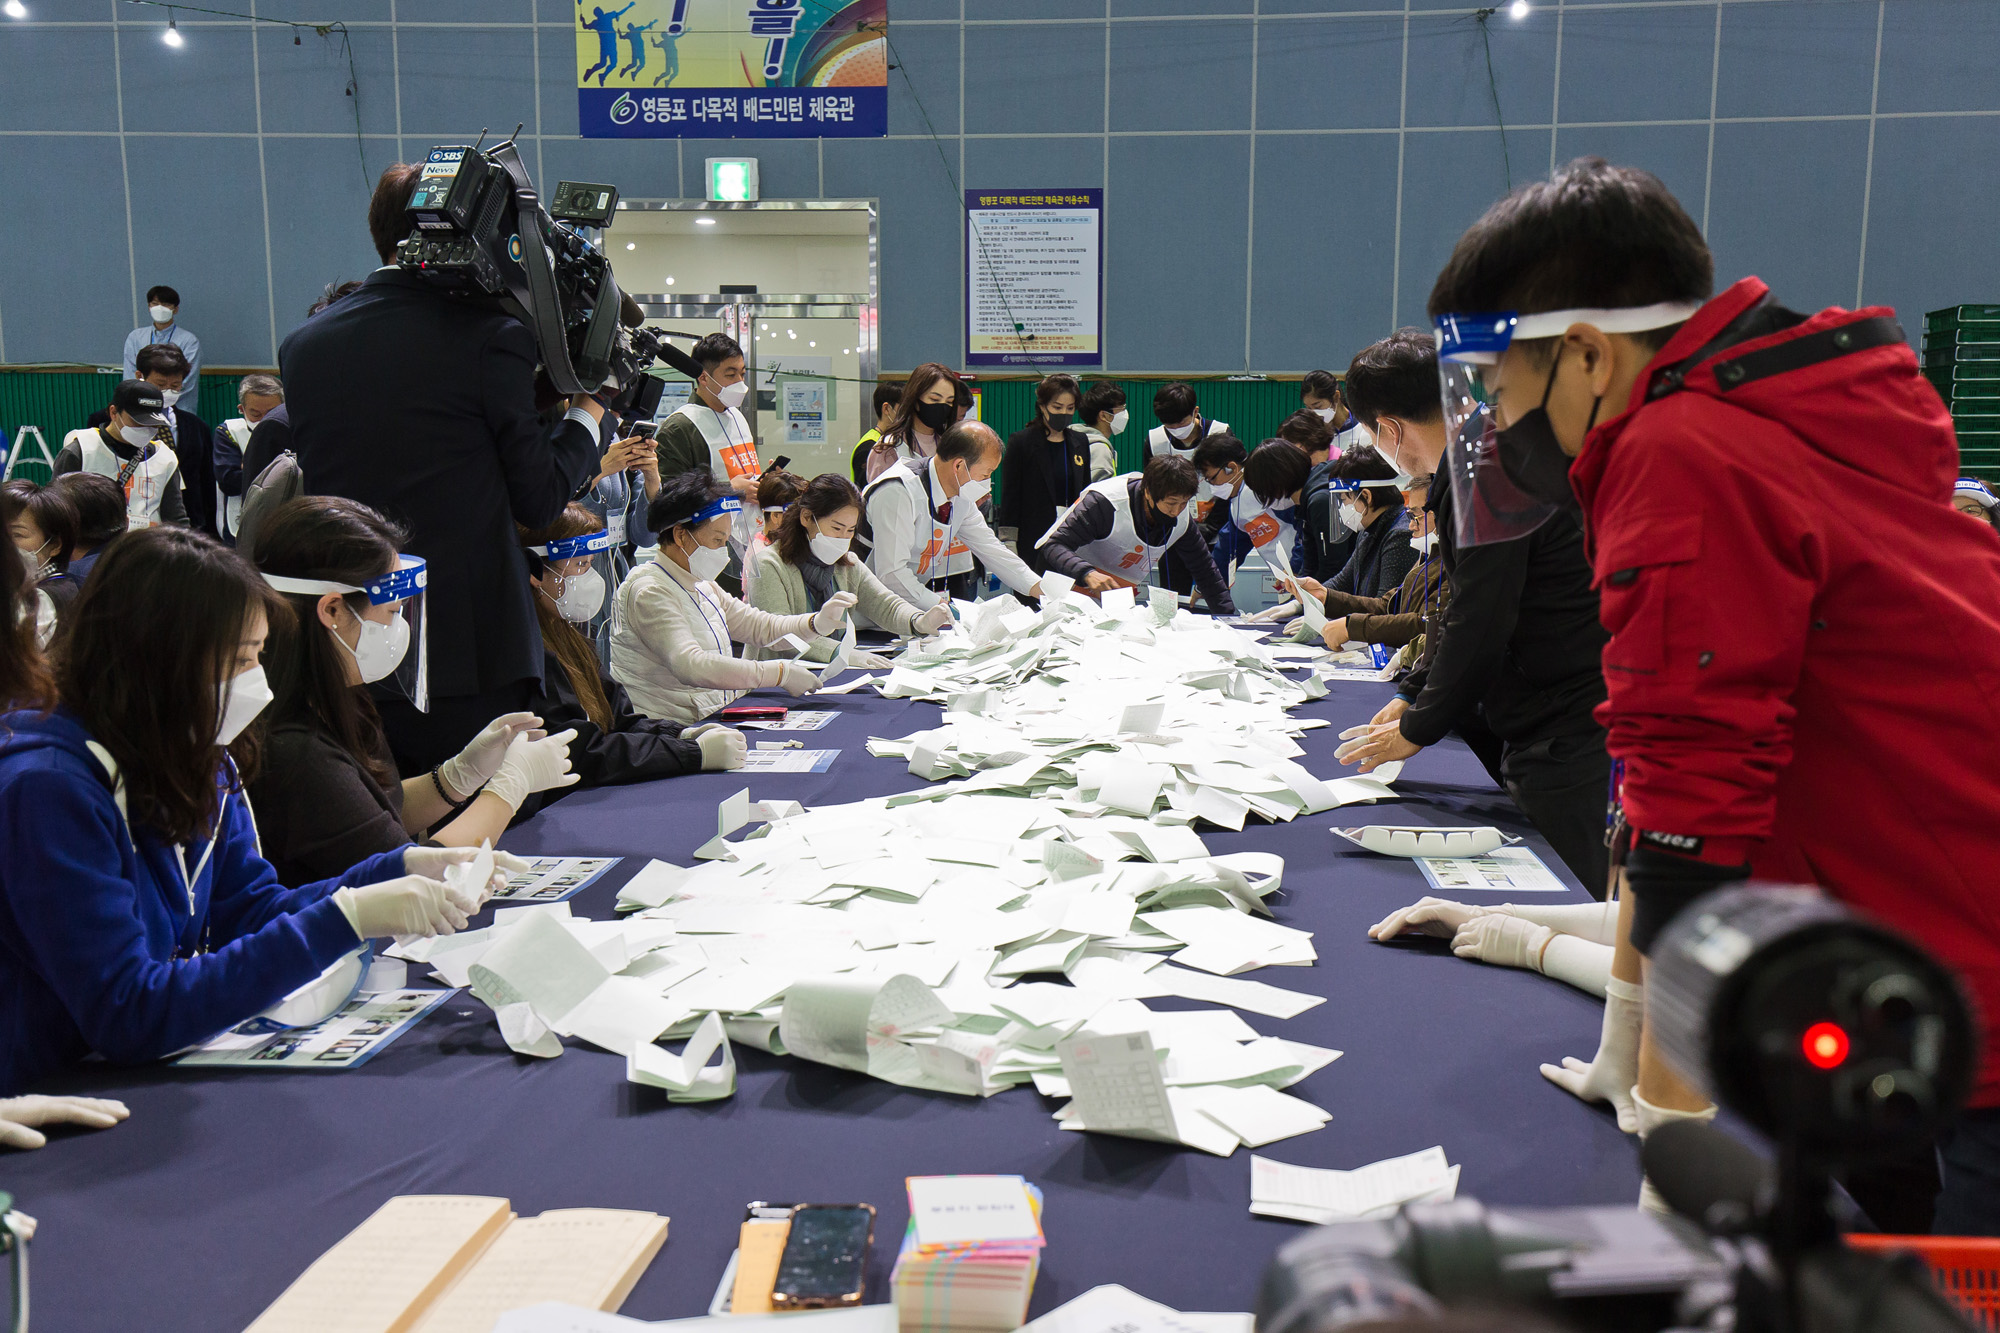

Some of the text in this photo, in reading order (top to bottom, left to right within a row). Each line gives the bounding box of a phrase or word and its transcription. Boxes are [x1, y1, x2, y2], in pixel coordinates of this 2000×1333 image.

[642, 96, 855, 123] 영등포 다목적 배드민턴 체육관
[442, 152, 463, 161] SBS
[427, 166, 455, 174] News
[979, 195, 1090, 206] 영등포 다목적 배드민턴 체육관 이용수칙
